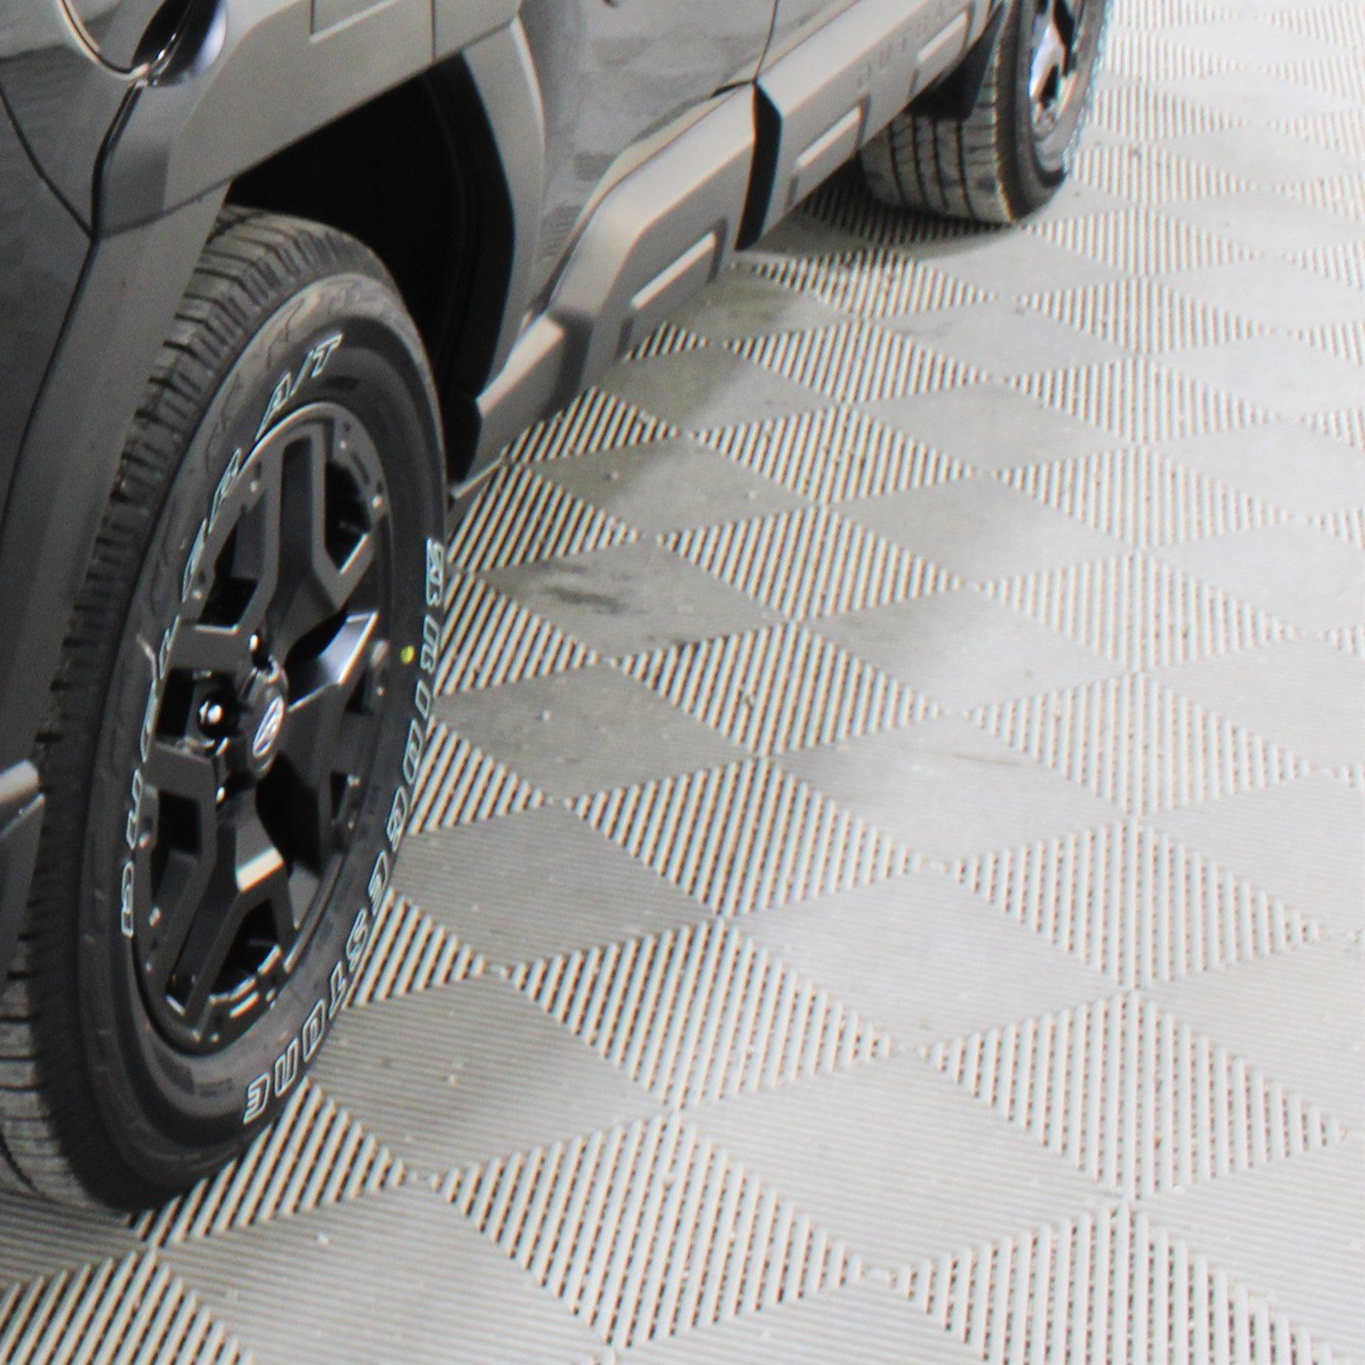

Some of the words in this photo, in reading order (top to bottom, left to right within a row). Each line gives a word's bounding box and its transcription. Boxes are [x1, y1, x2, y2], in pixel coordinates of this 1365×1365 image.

[121, 447, 242, 937] DUELER
[256, 333, 344, 440] A/T
[243, 537, 445, 1125] BRIDGESTONE
